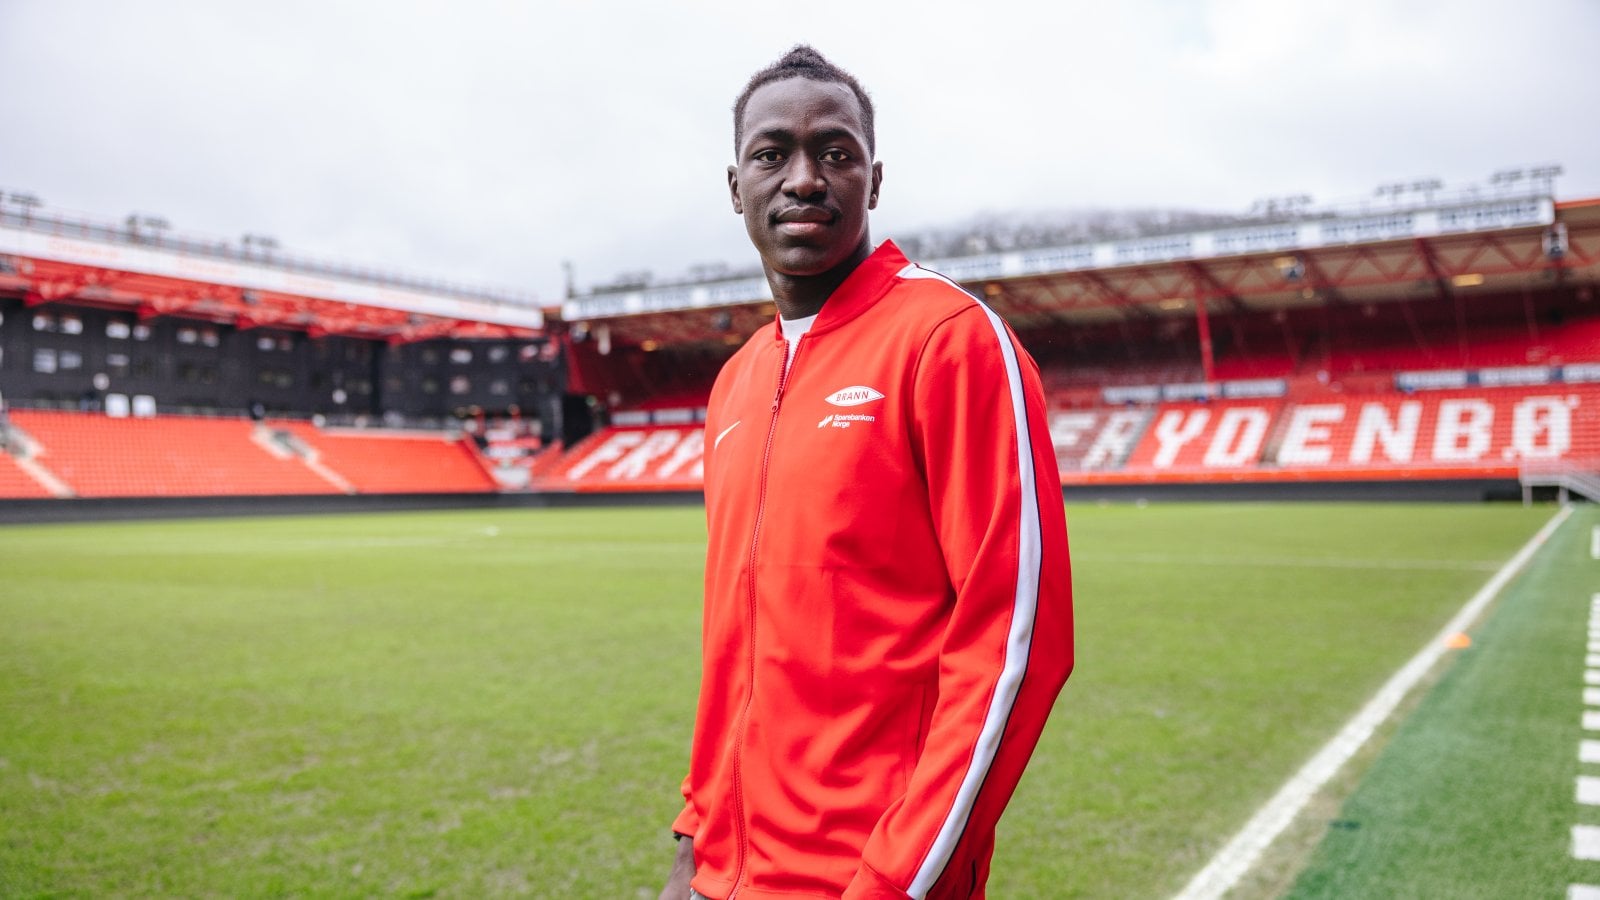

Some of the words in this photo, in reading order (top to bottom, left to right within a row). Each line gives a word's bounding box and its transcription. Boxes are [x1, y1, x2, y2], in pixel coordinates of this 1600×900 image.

[836, 390, 869, 402] BRANN
[833, 414, 875, 423] Sparebanken
[831, 421, 850, 429] Norge
[566, 429, 705, 481] FRY
